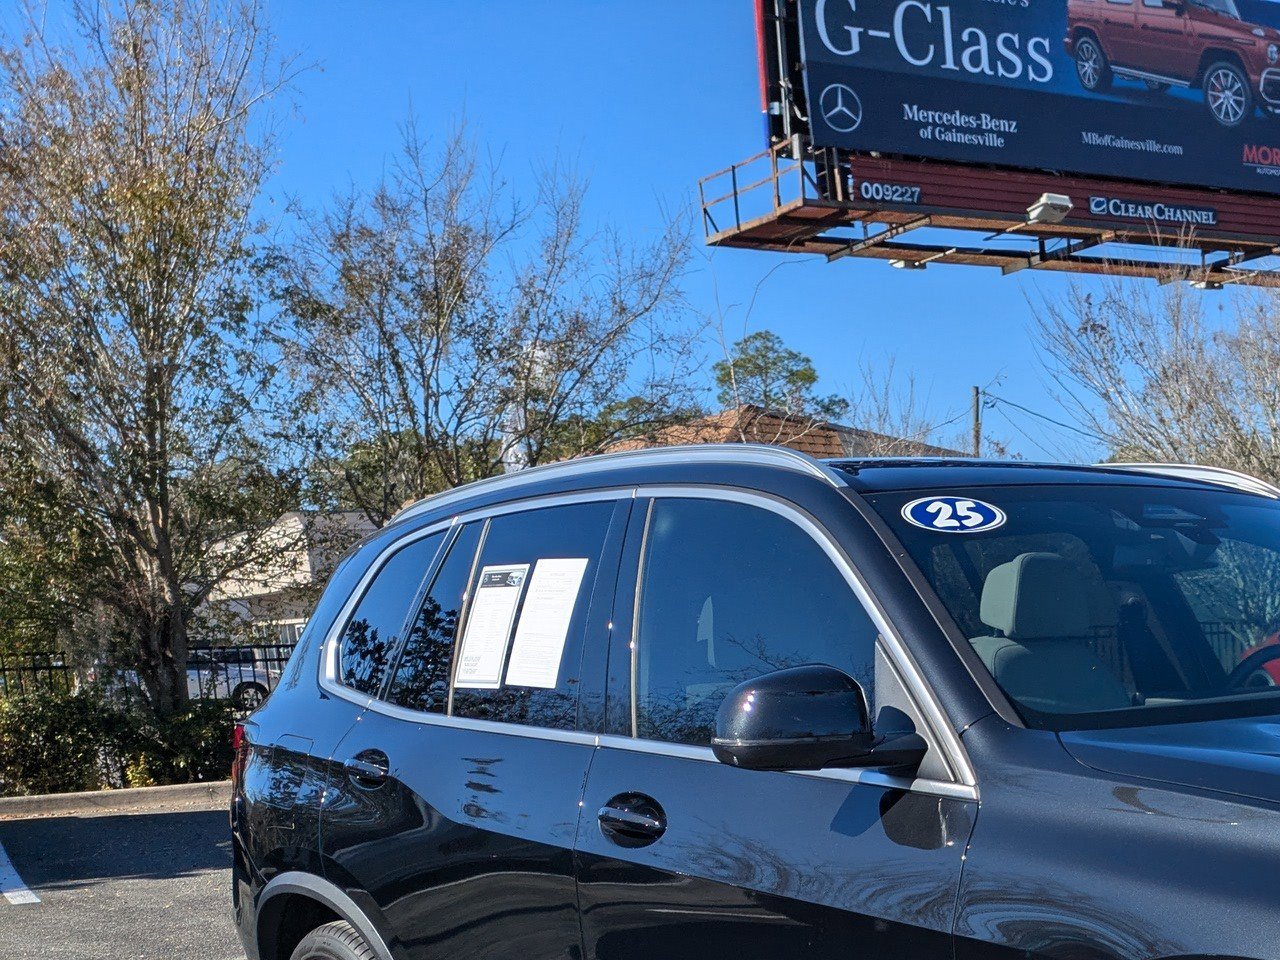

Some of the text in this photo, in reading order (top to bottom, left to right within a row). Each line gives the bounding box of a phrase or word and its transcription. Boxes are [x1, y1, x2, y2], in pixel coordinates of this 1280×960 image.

[815, 0, 1054, 83] G-Class
[902, 103, 1018, 133] Mercedes-Benz
[919, 126, 1005, 148] of Gainesville
[1081, 131, 1183, 156] MBofGainesville.com
[860, 182, 921, 203] 009227
[925, 501, 984, 528] 25
